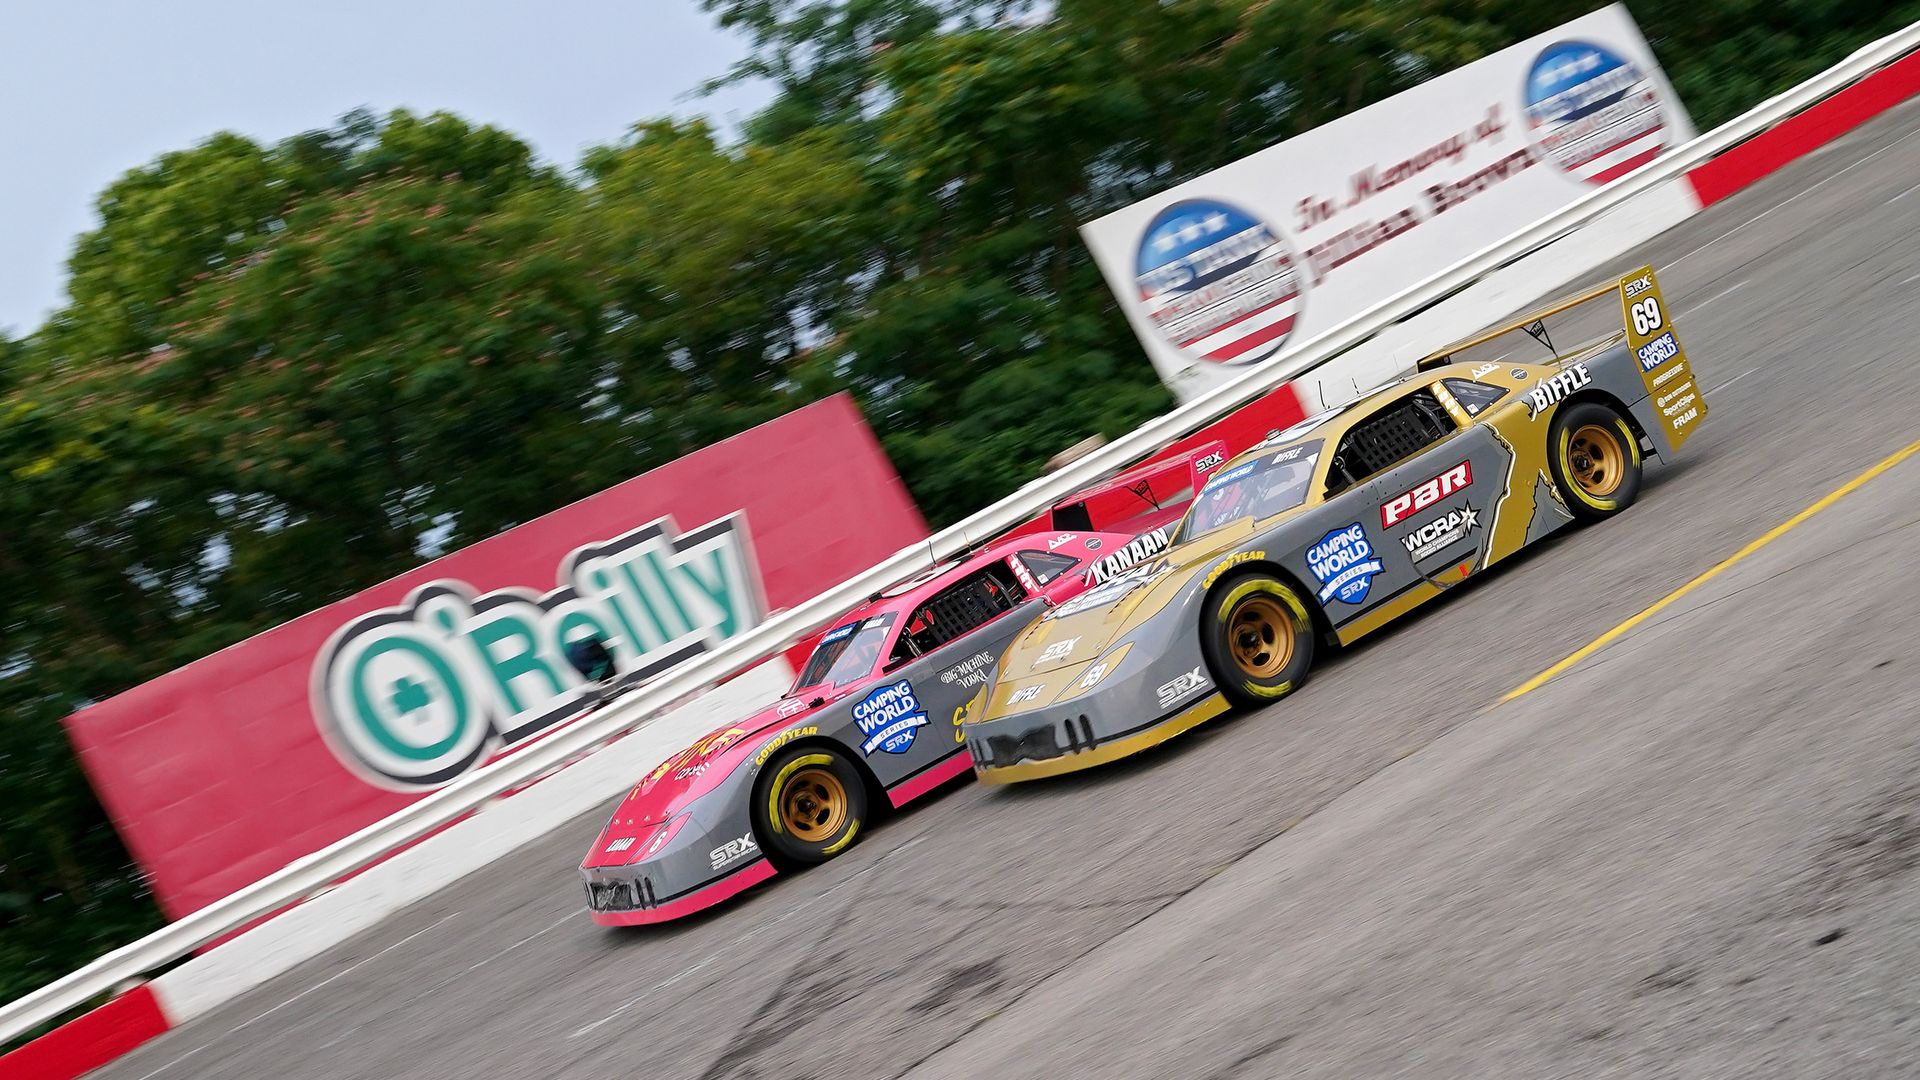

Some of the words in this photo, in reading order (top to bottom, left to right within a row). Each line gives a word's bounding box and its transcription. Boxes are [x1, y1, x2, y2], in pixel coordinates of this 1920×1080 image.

[1348, 133, 1466, 207] Memory
[1625, 275, 1652, 296] SRX
[1631, 296, 1662, 336] 69
[1638, 333, 1673, 359] CAMPING
[1642, 343, 1677, 369] WORLD
[1529, 363, 1592, 413] BIFFLE
[1673, 407, 1698, 429] FRAM
[1195, 451, 1223, 471] SRX
[1384, 464, 1467, 525] PBR
[1307, 525, 1363, 564] CAMPING
[1401, 511, 1461, 552] WCRA
[1090, 527, 1169, 585] KANAAN
[1202, 551, 1266, 589] GOODYEAR
[1311, 541, 1369, 580] WORLD
[1336, 566, 1363, 585] SERIES
[1340, 576, 1369, 600] SRX
[353, 545, 737, 761] O'Reilly
[941, 668, 959, 684] BIG
[956, 651, 995, 676] MACHINE
[956, 669, 988, 688] VODKA
[1157, 666, 1207, 703] SRX
[854, 682, 910, 719] CAMPING
[858, 696, 915, 733] WORLD
[755, 727, 818, 765] GOODYEAR
[880, 720, 909, 738] SERIES
[885, 730, 914, 752] SRX
[649, 831, 667, 852] 6
[709, 832, 757, 864] SRX
